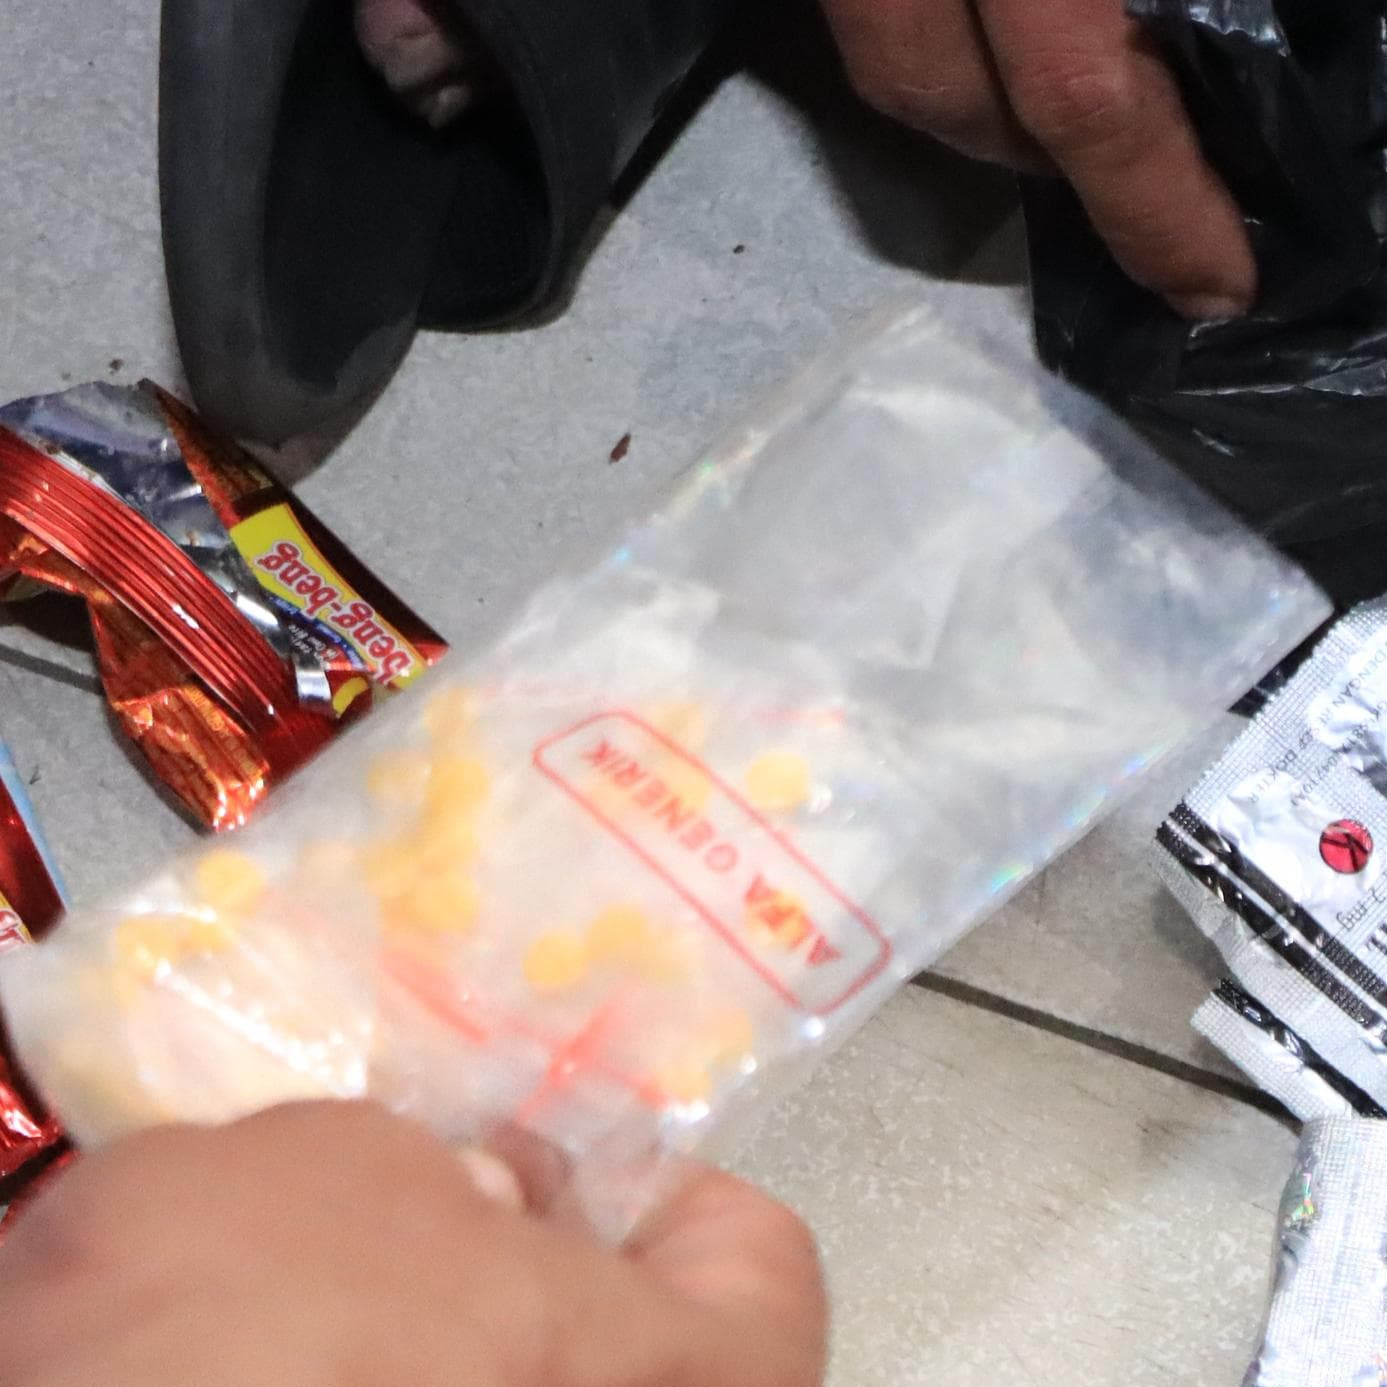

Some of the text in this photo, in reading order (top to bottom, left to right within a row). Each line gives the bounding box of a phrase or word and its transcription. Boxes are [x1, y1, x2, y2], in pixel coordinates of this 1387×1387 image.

[255, 539, 412, 685] beng-beng
[746, 876, 841, 968] ALFA
[1336, 897, 1371, 934] mg
